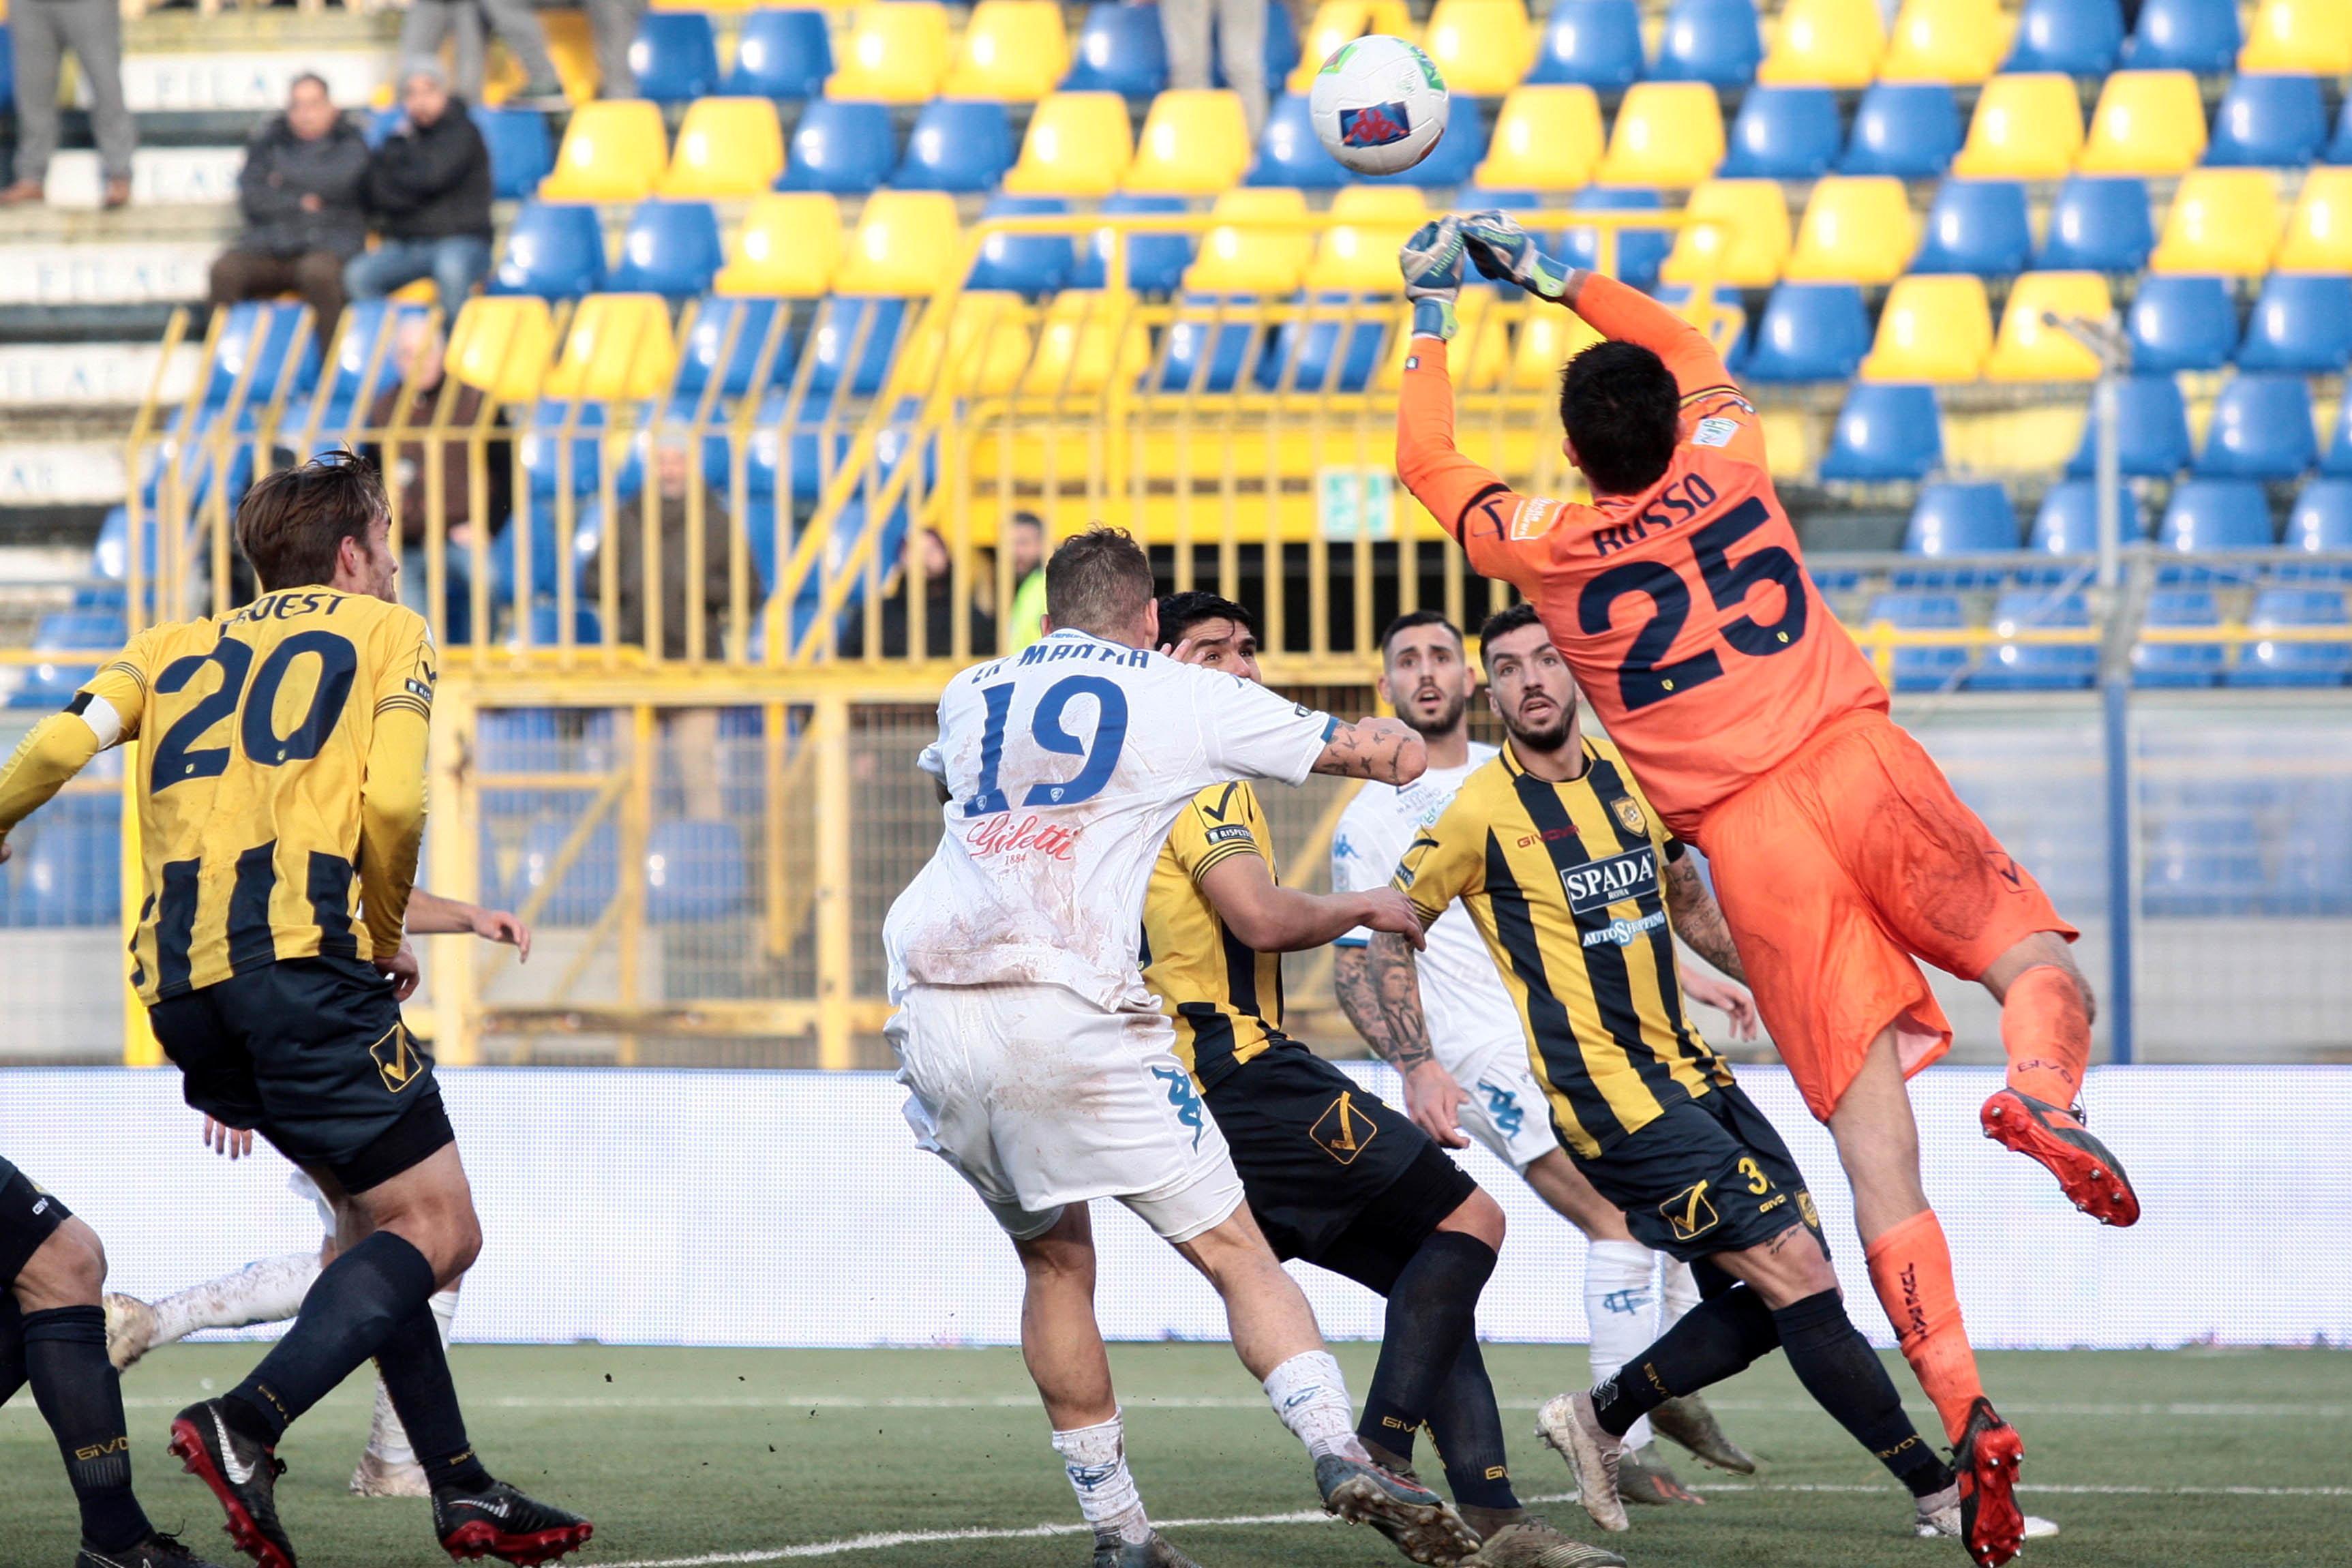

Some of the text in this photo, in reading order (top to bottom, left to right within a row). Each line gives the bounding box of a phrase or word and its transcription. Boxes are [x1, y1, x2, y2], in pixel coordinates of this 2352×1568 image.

[1593, 472, 1717, 557] RUSSO
[1578, 496, 1807, 712] 25
[151, 630, 357, 795] 20
[963, 674, 1128, 817] 19
[967, 813, 1081, 860] Giletti
[1005, 853, 1027, 865] 1884
[1517, 823, 1580, 849] GIVOVA
[1567, 854, 1654, 901] SPADA
[1738, 1156, 1768, 1195] 3
